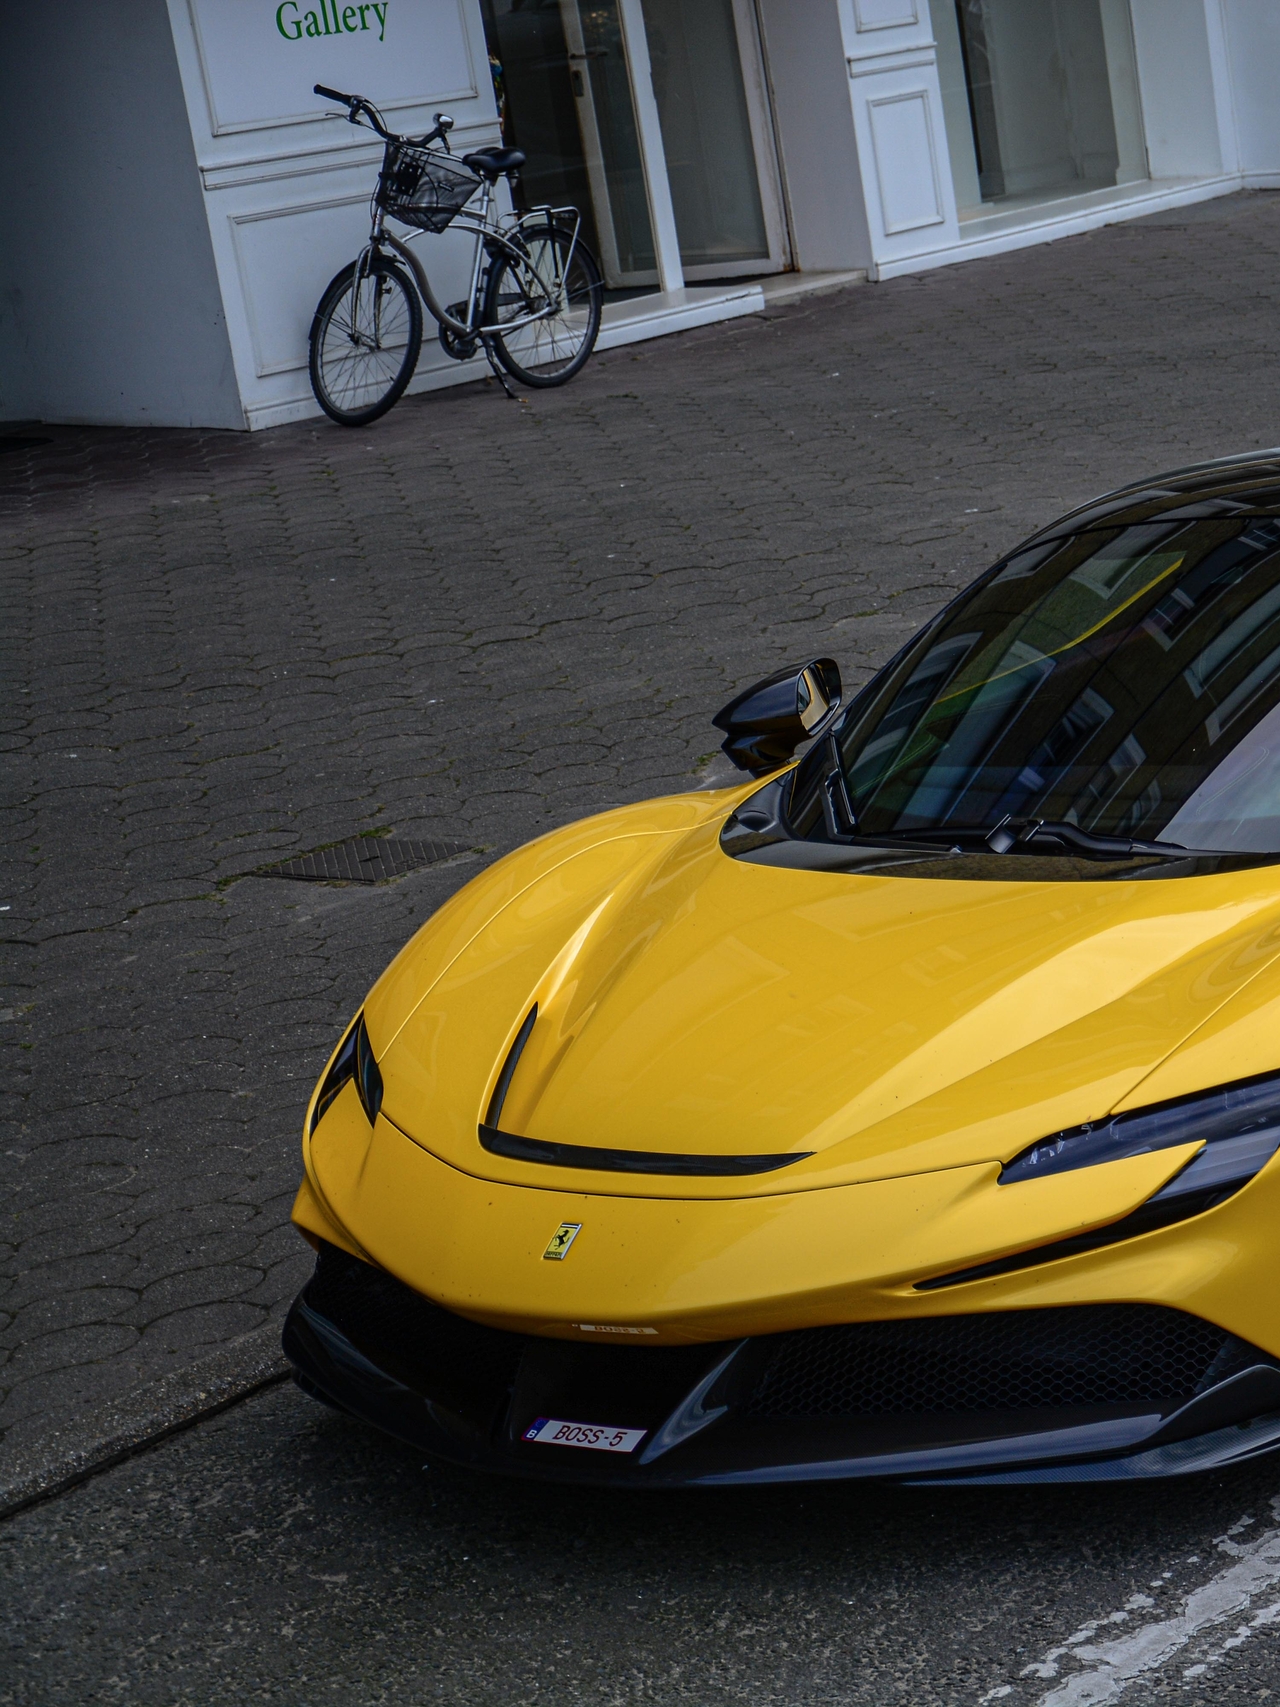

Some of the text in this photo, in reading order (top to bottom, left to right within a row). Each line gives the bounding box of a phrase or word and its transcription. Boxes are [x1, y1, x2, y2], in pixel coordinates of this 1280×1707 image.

[275, 0, 388, 42] Gallery
[526, 1425, 628, 1447] B BOSS-5
